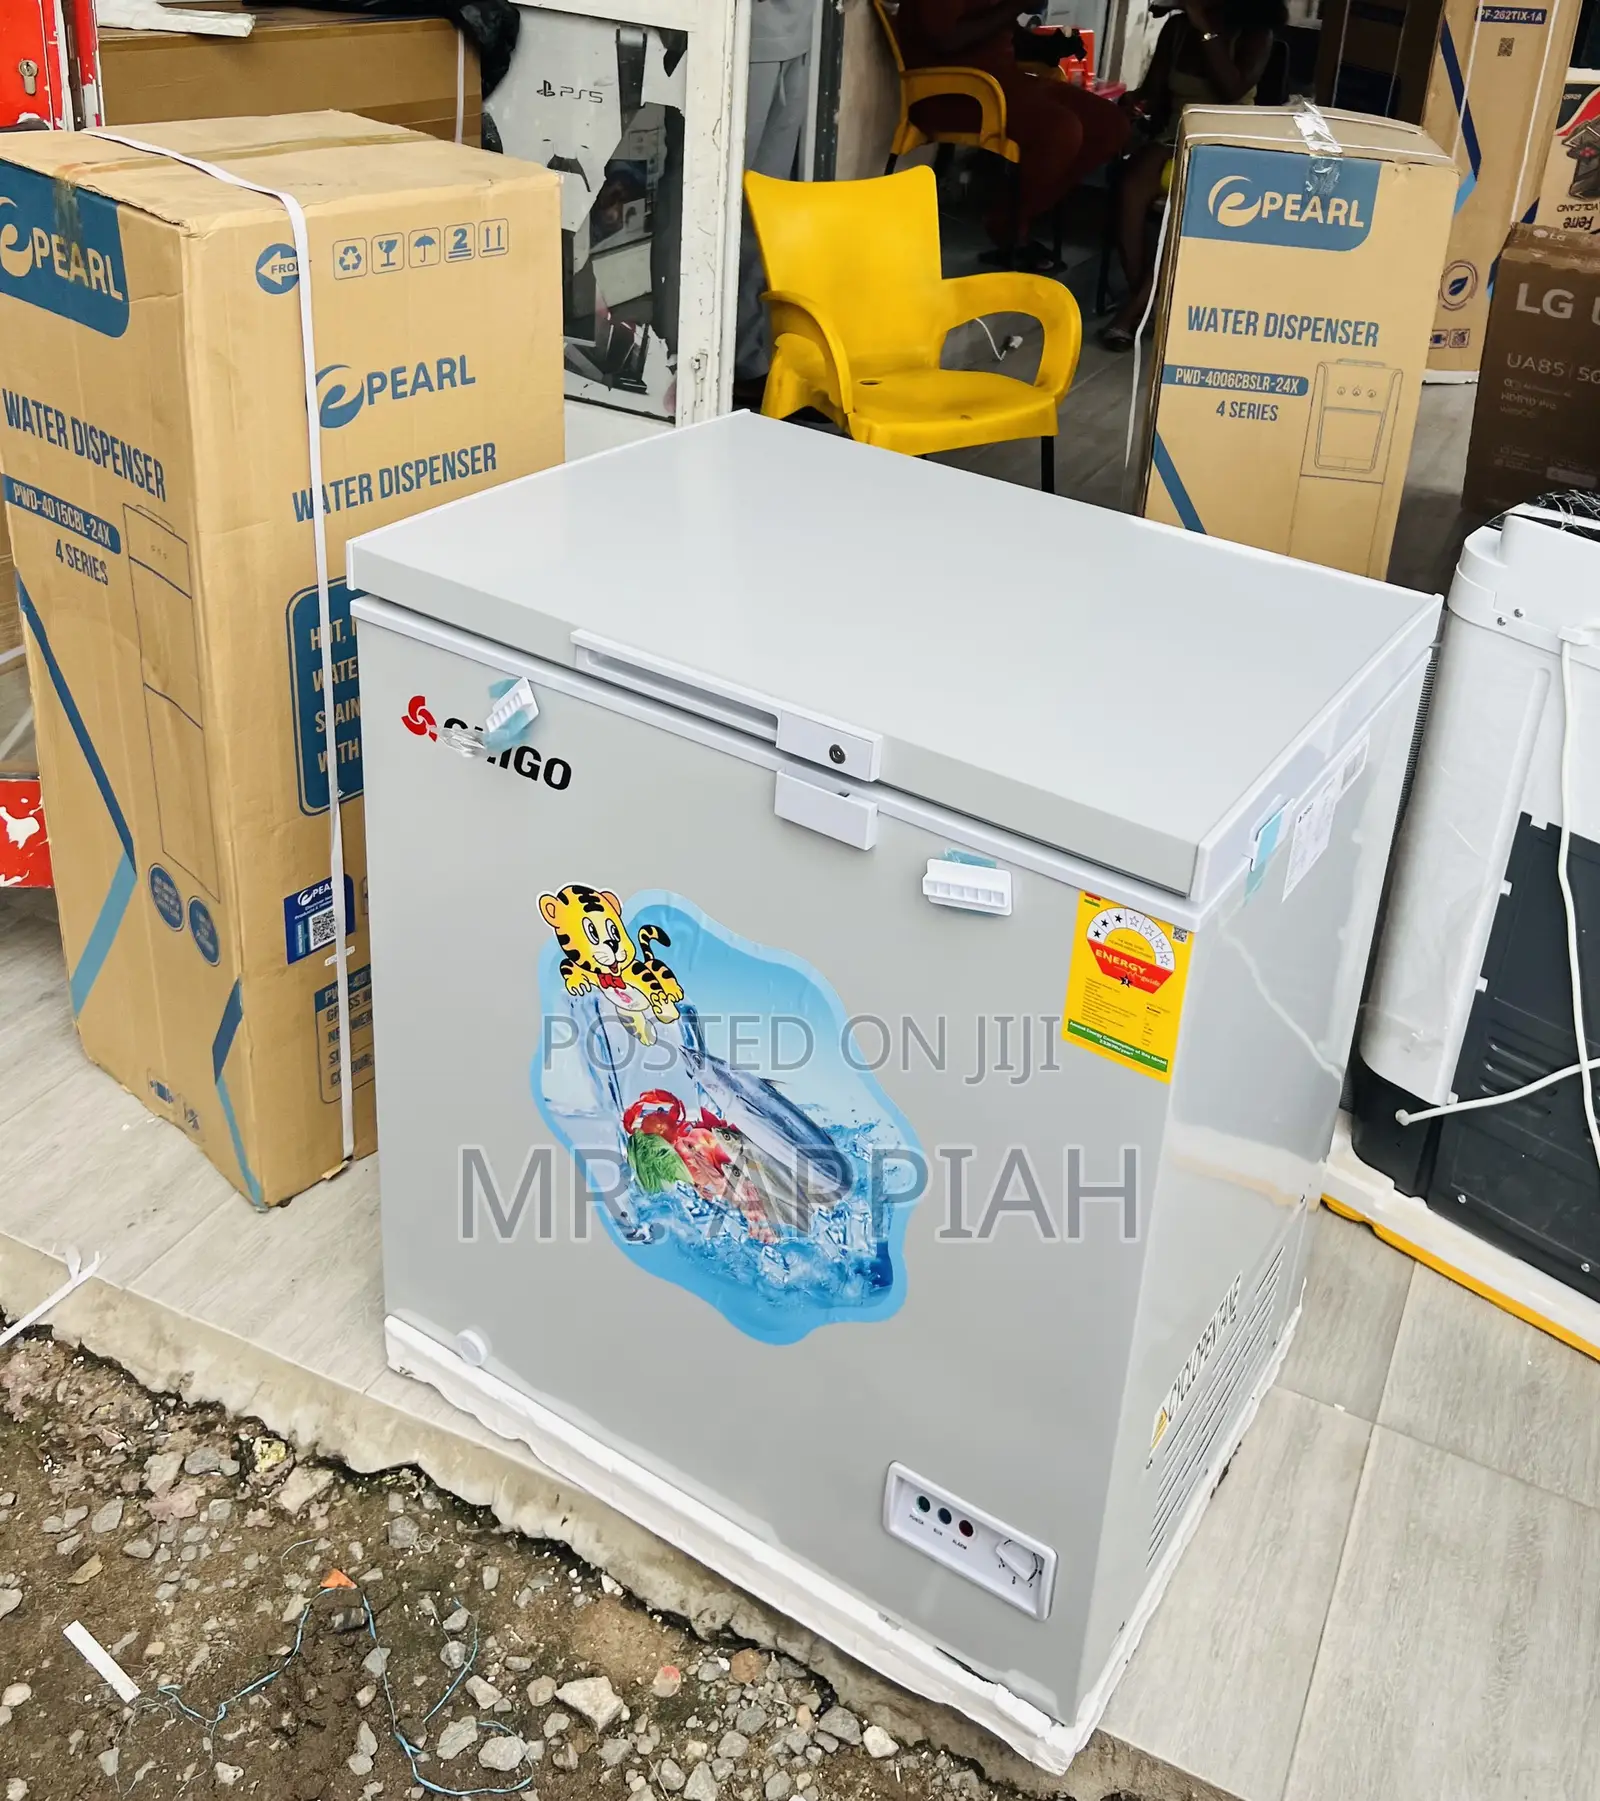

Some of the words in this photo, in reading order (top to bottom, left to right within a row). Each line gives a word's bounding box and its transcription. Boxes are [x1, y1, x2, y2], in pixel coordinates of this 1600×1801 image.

[560, 86, 604, 104] PS5
[1261, 191, 1365, 228] PEARL
[1563, 215, 1594, 230] Ferre
[32, 226, 123, 301] PEARL
[270, 259, 304, 275] FRO
[1515, 282, 1575, 319] LG
[1188, 304, 1260, 336] WATER
[1263, 312, 1380, 348] DISPENSER
[366, 354, 476, 406] PEARL
[1175, 367, 1300, 394] PWD-4006CBSLR-24X
[1507, 352, 1565, 377] UA85
[1215, 400, 1226, 417] 4
[1228, 401, 1279, 421] SERIES
[2, 388, 69, 450] WATER
[70, 415, 166, 503] DISPENSER
[291, 472, 374, 523] WATER
[378, 442, 497, 499] DISPENSER
[13, 483, 111, 548] PWD-4015CBL-24X
[55, 538, 64, 564] 4
[65, 543, 109, 586] SERIES
[310, 617, 348, 652] HT,
[317, 737, 360, 774] WTH
[312, 880, 333, 898] PEA
[1095, 949, 1147, 975] ENERGY
